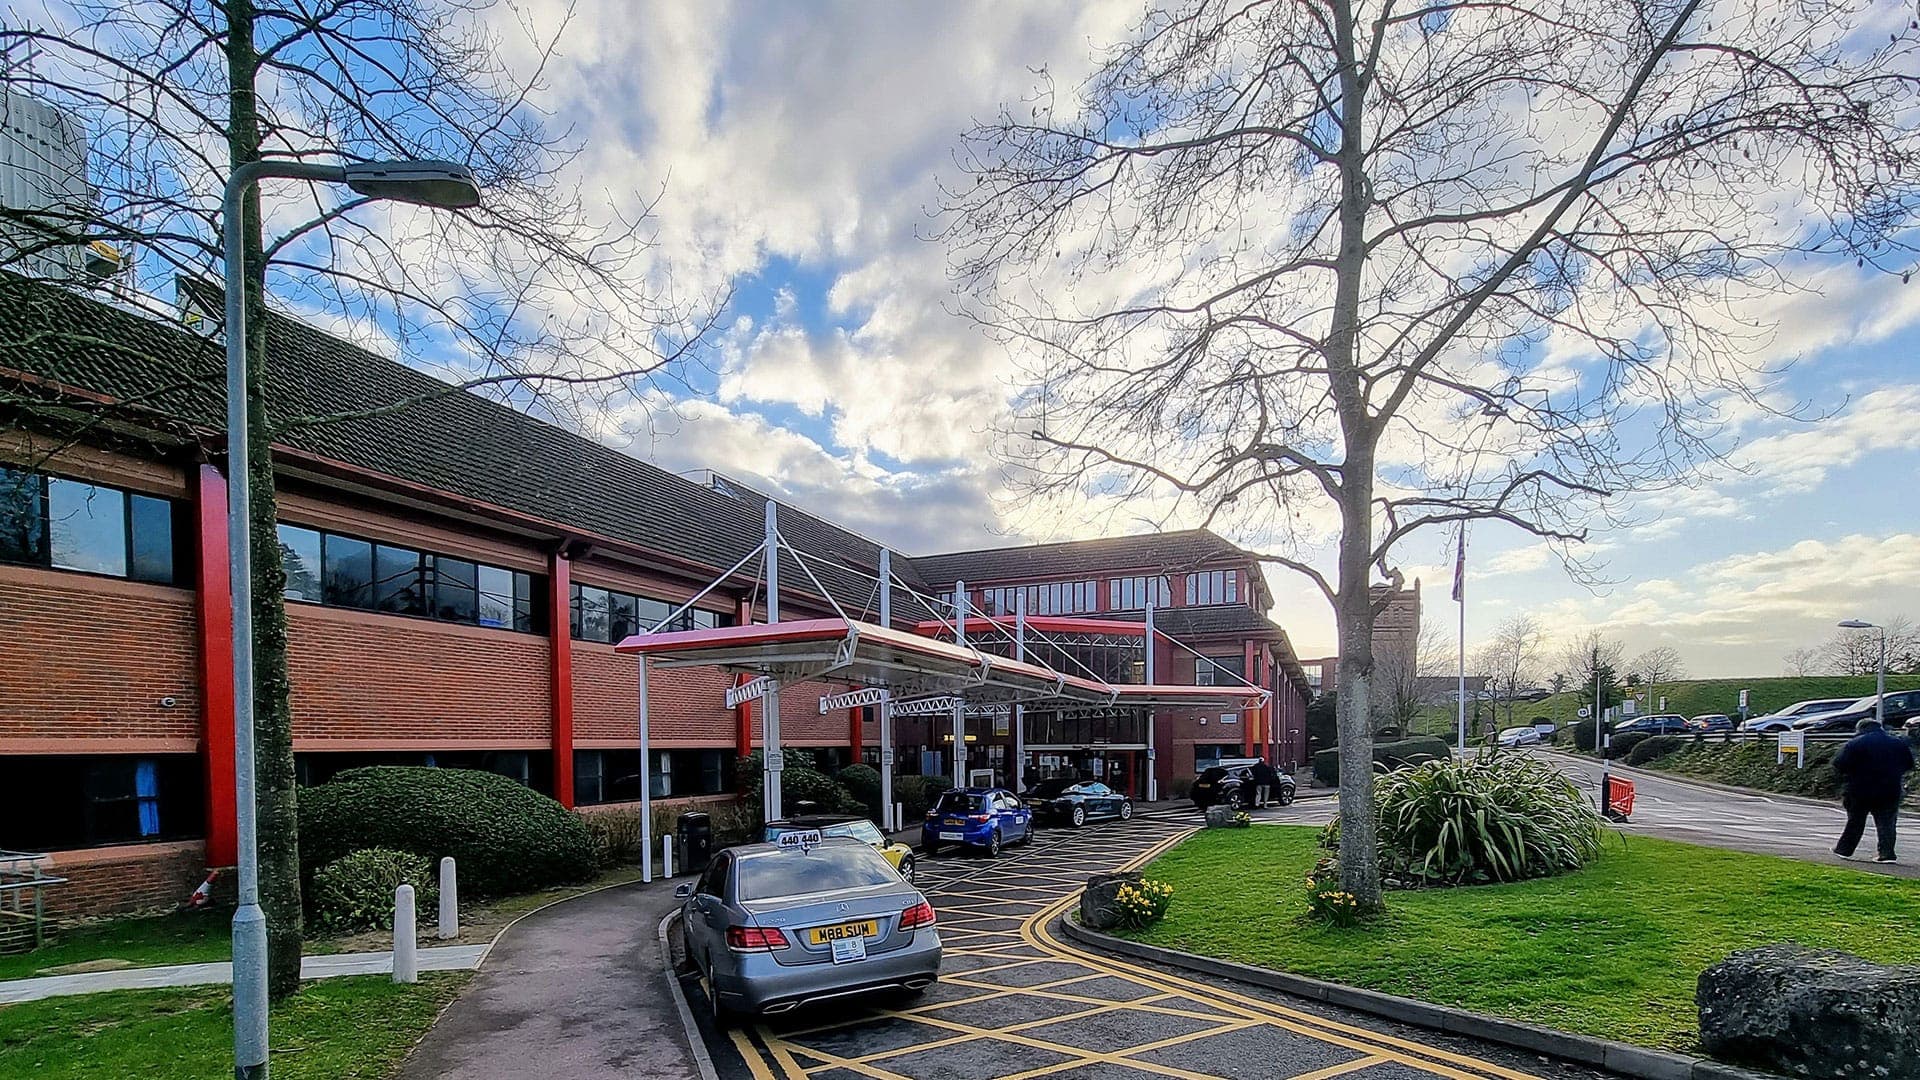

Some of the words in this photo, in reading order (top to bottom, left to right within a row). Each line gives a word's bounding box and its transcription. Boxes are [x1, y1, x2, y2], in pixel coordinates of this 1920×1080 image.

[781, 835, 799, 845] 440
[801, 833, 819, 843] 440
[845, 923, 870, 938] SUM
